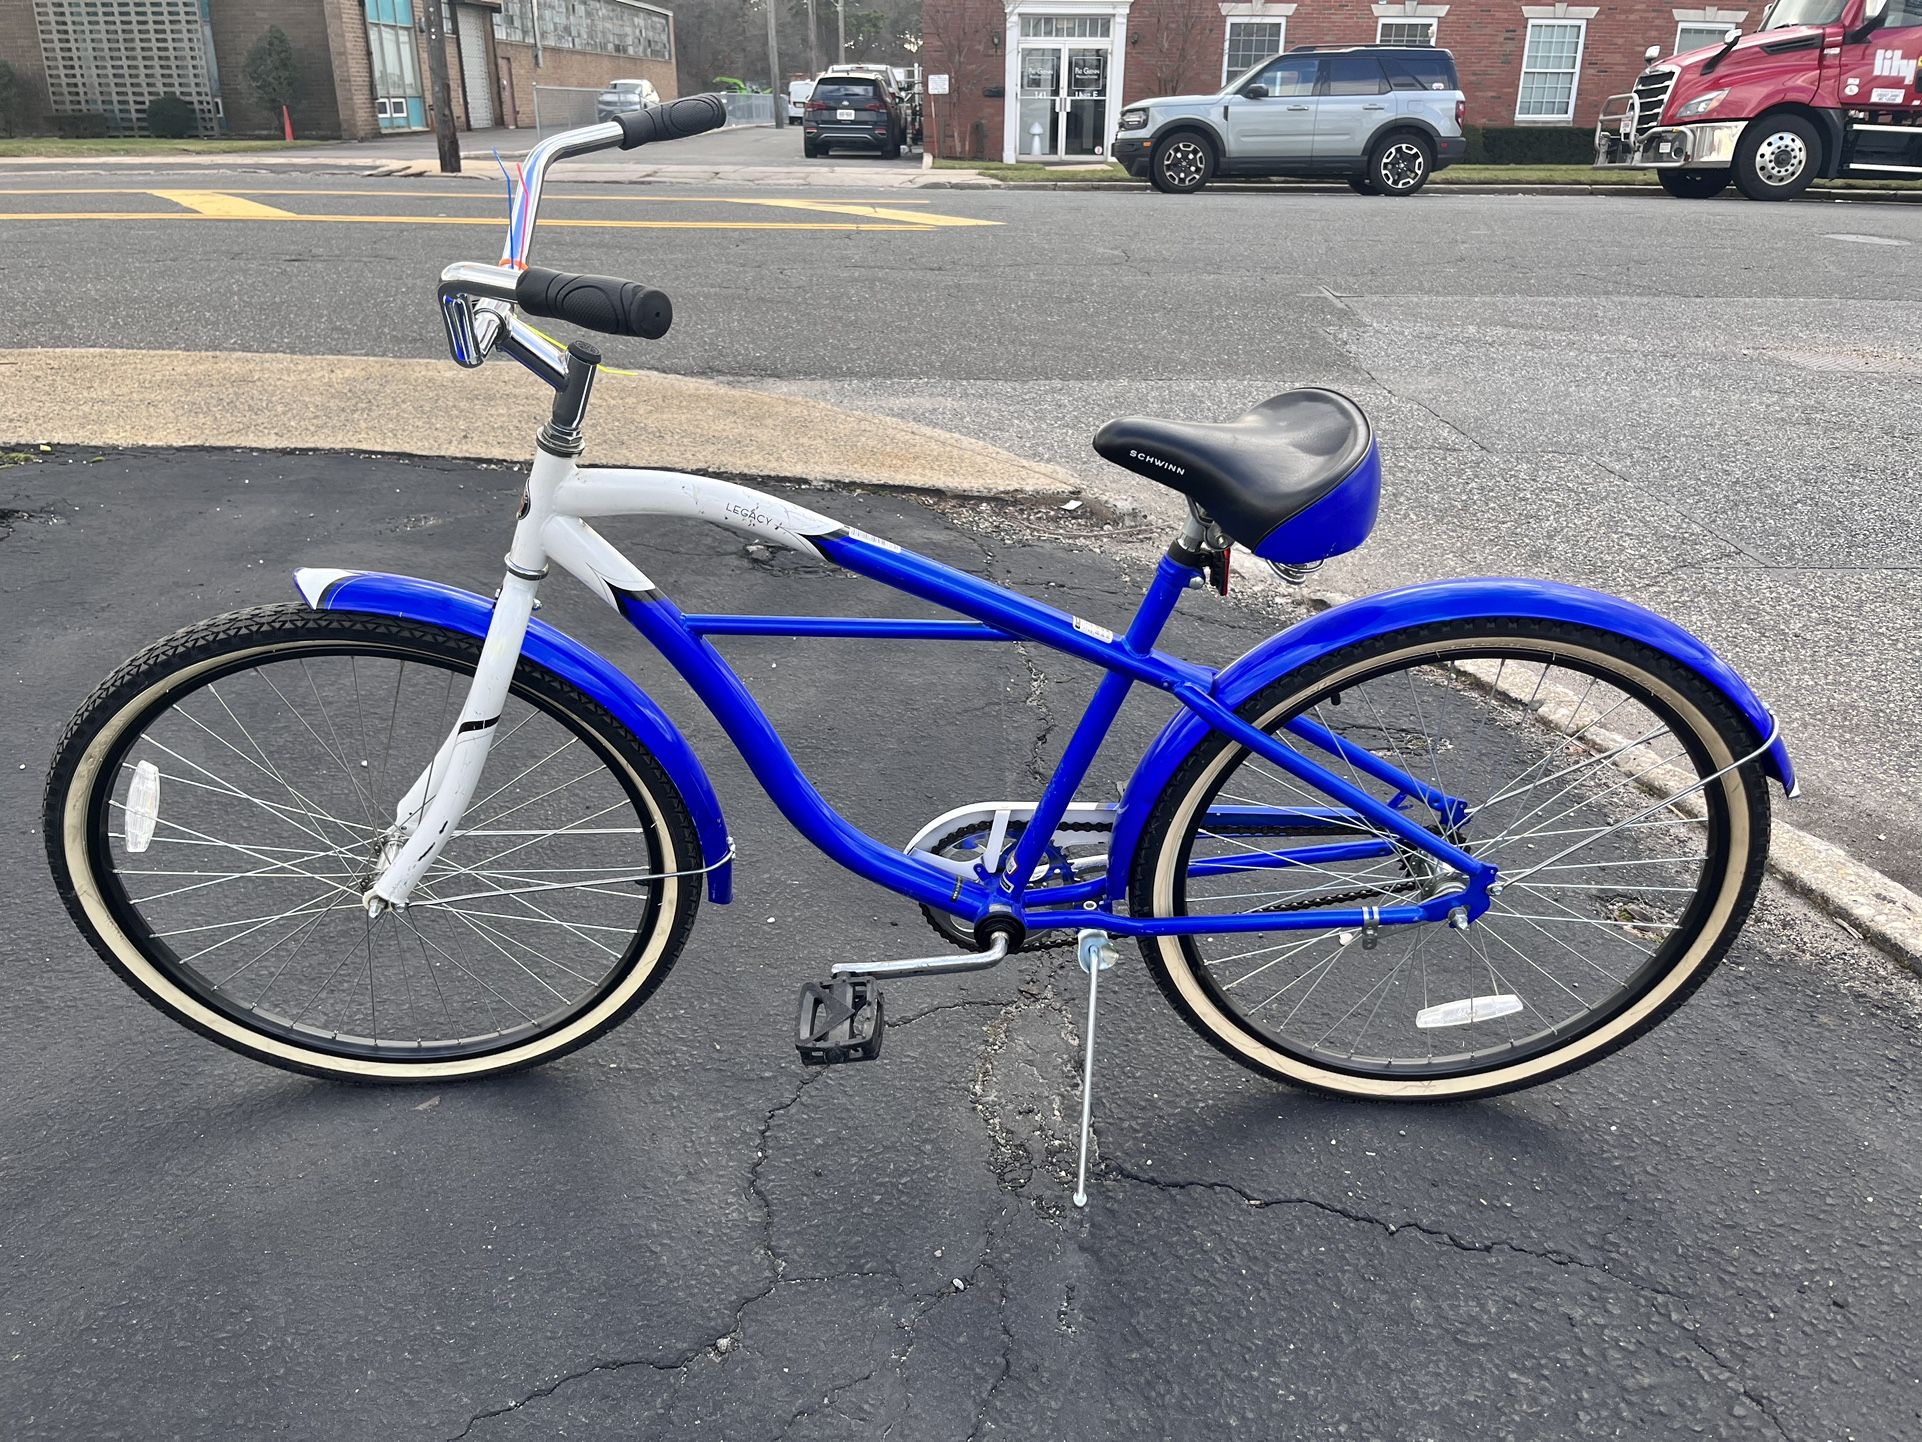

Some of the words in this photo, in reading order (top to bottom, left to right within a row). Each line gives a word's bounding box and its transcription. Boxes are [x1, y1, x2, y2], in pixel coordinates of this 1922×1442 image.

[1873, 49, 1917, 85] lily
[1129, 449, 1185, 476] SCHWINN
[725, 502, 773, 525] LEGACY
